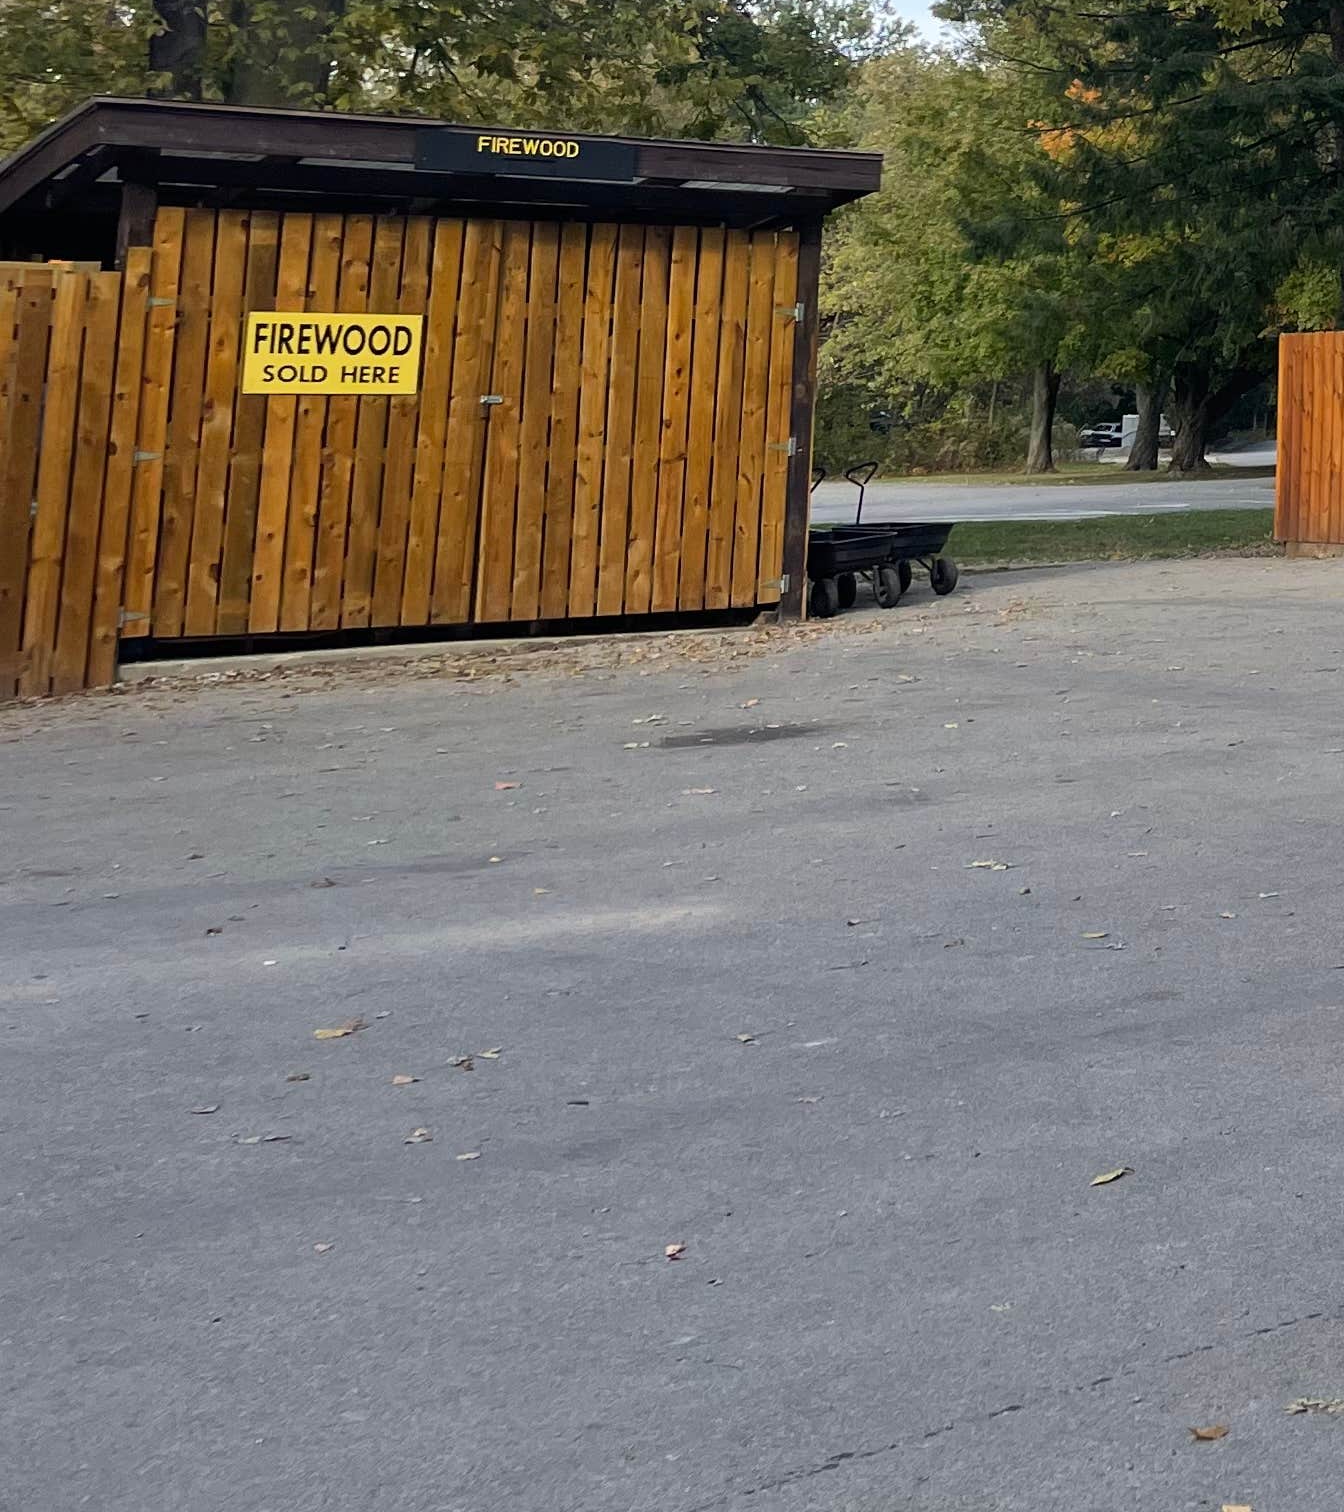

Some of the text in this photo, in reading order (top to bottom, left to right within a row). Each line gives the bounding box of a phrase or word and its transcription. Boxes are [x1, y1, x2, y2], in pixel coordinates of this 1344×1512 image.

[477, 135, 580, 158] FIREWOOD
[253, 322, 413, 356] FIREWOOD
[262, 364, 401, 384] SOLD HERE
